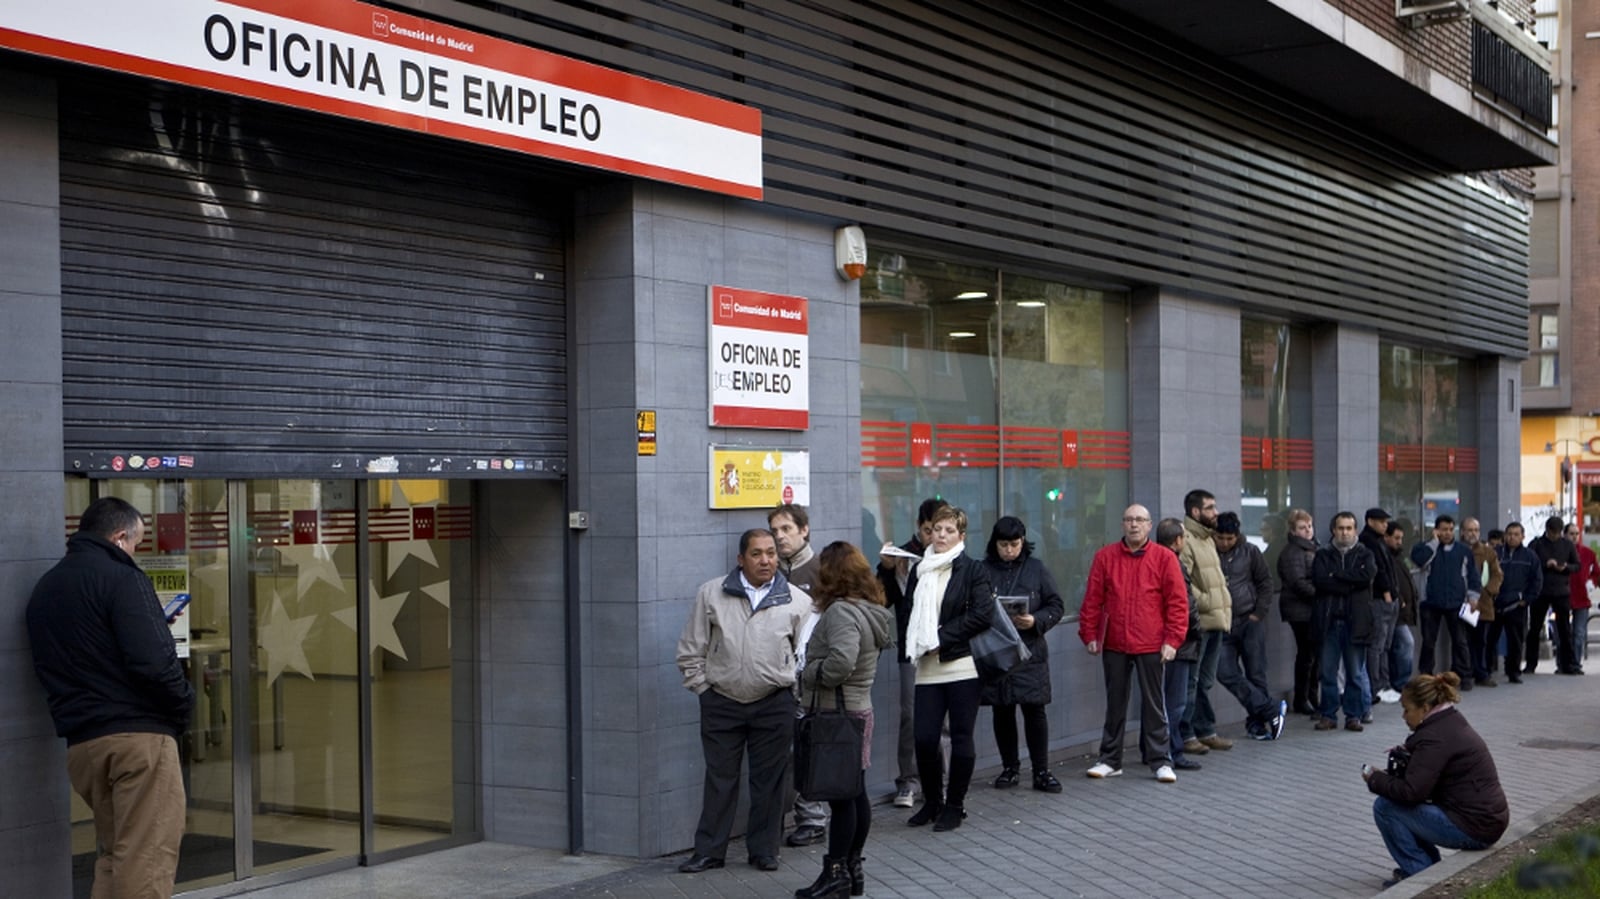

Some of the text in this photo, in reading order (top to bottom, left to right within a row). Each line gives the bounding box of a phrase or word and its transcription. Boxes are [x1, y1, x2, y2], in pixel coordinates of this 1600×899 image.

[389, 23, 474, 52] Comunidad de Madrid
[204, 14, 601, 142] OFICINA DE EMPLEO
[733, 302, 802, 321] Comunidad de Madrid
[721, 342, 801, 369] OFICINA DE
[732, 370, 791, 394] EMPLEO
[156, 575, 186, 590] PREVIA
